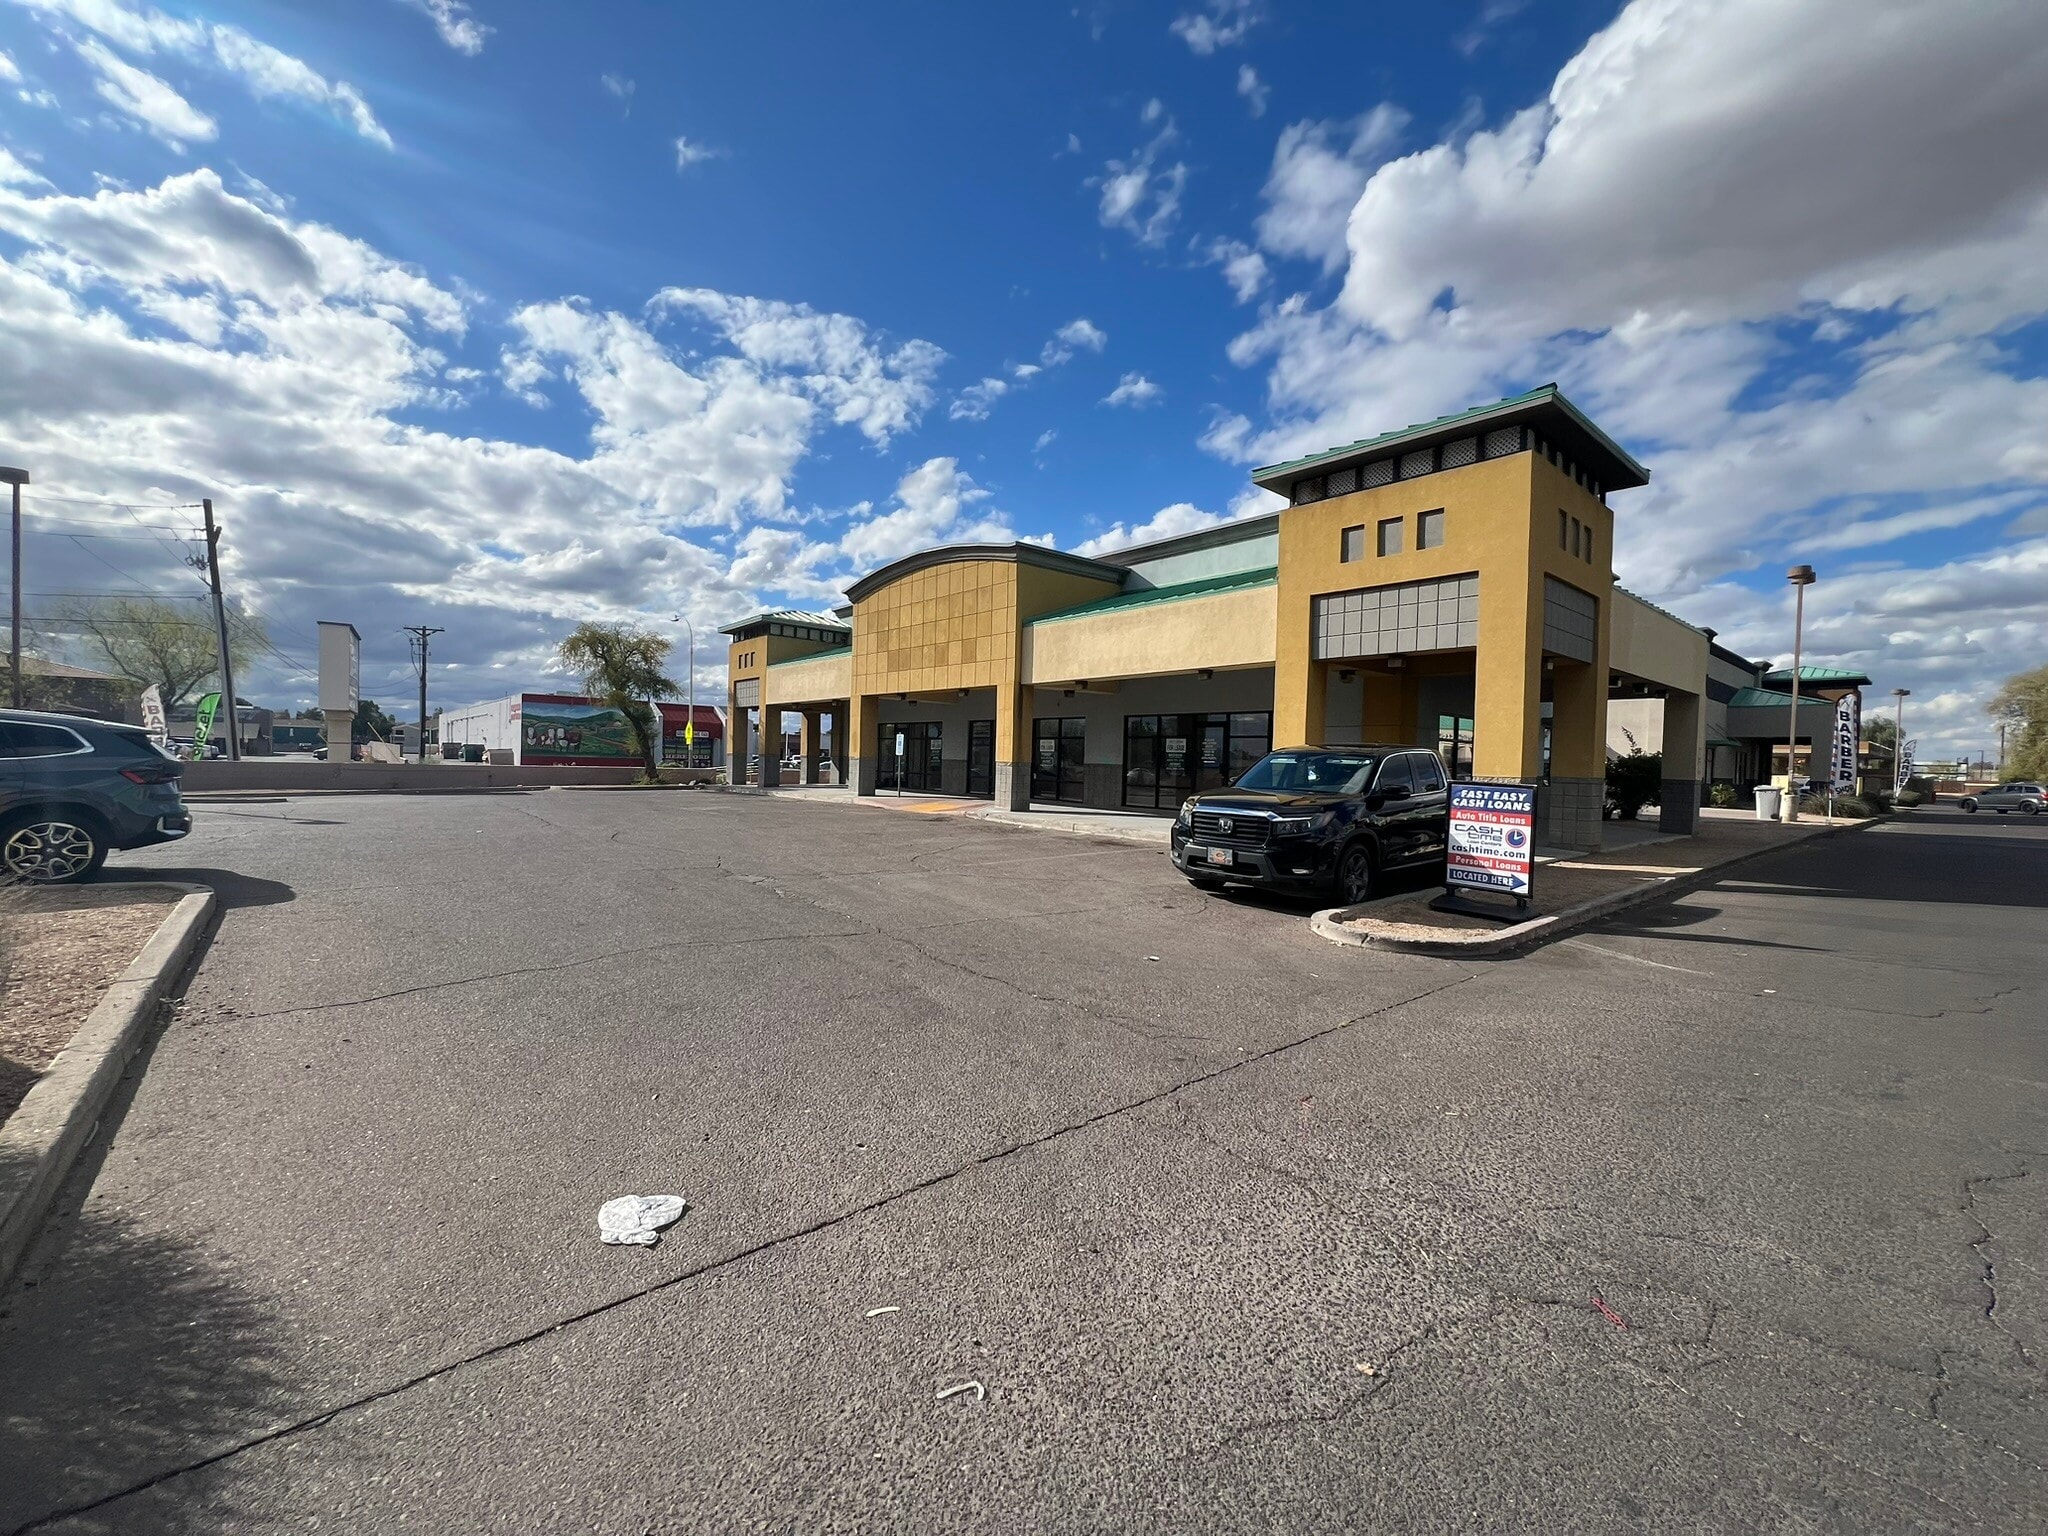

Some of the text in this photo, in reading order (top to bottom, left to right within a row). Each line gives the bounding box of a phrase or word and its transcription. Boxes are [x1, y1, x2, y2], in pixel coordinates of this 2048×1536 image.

[1839, 711, 1853, 781] BARBER
[1461, 789, 1527, 802] FAST EASY
[1835, 784, 1855, 795] SHOP
[1452, 797, 1531, 812] CASH LOANS
[1455, 811, 1526, 825] Auto Title Loans
[1454, 823, 1503, 835] CASH
[1468, 832, 1503, 842] time
[1452, 843, 1526, 859] cashtime.com
[1455, 855, 1522, 871] Personal Loans
[1453, 870, 1514, 886] LOCATED HERE
